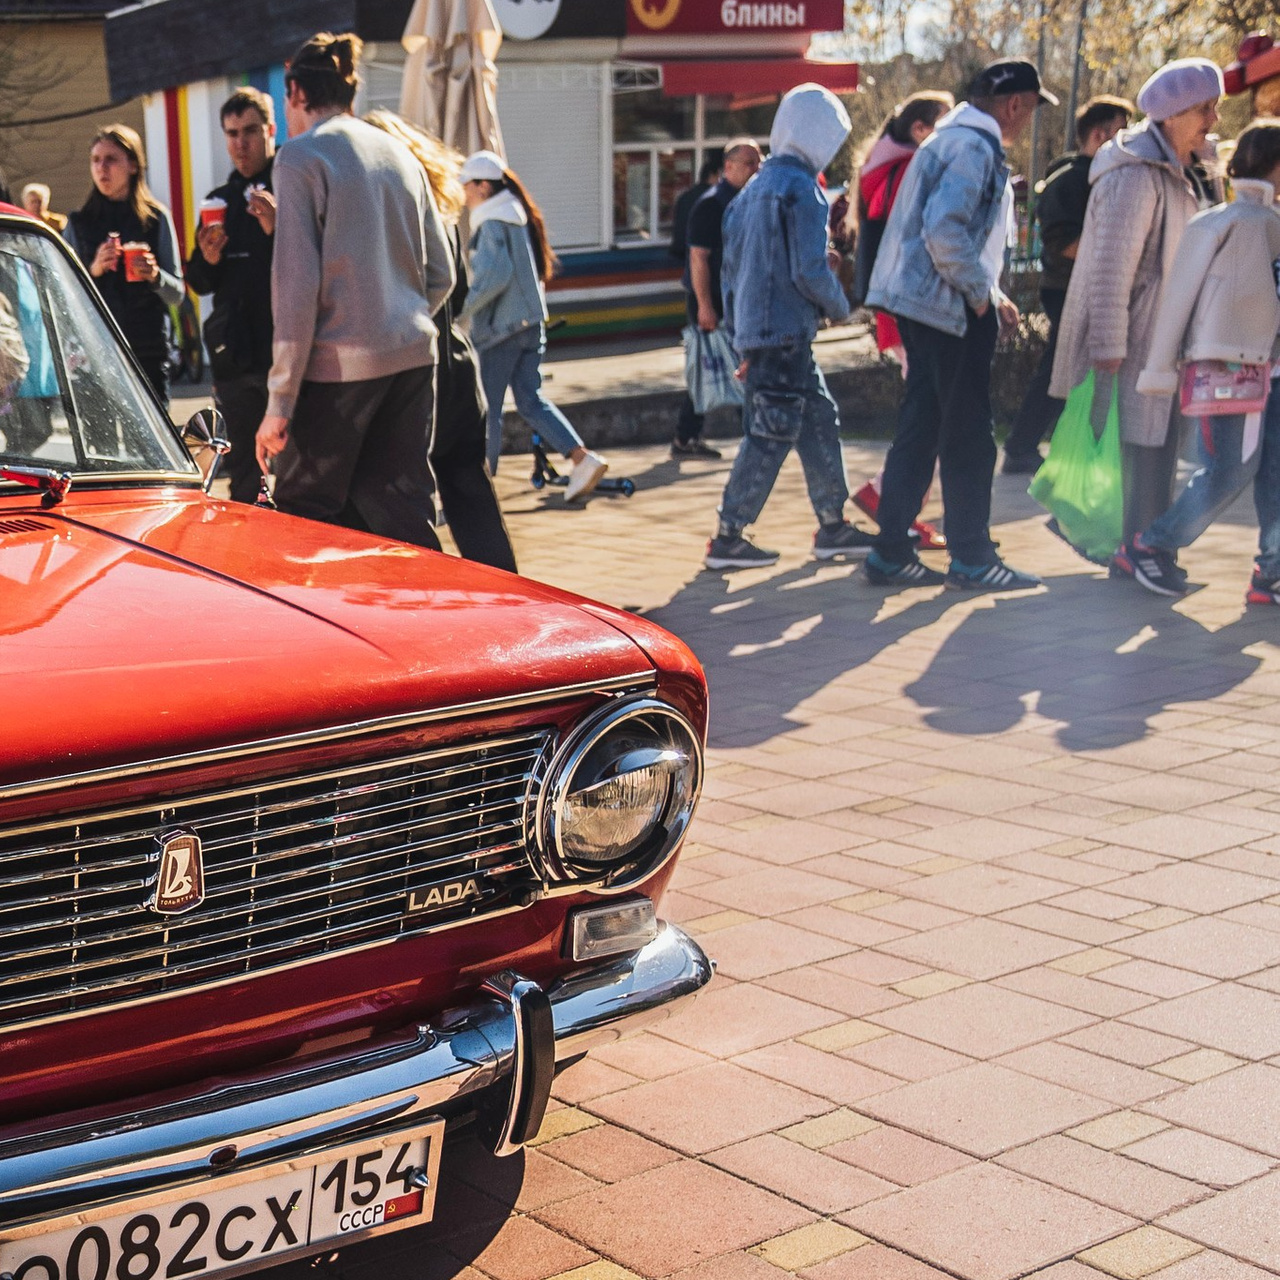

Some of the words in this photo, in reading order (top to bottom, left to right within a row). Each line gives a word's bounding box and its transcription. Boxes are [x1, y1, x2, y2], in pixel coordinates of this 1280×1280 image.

[409, 879, 480, 911] LADA
[320, 1143, 418, 1213] 154
[340, 1203, 383, 1232] СССР
